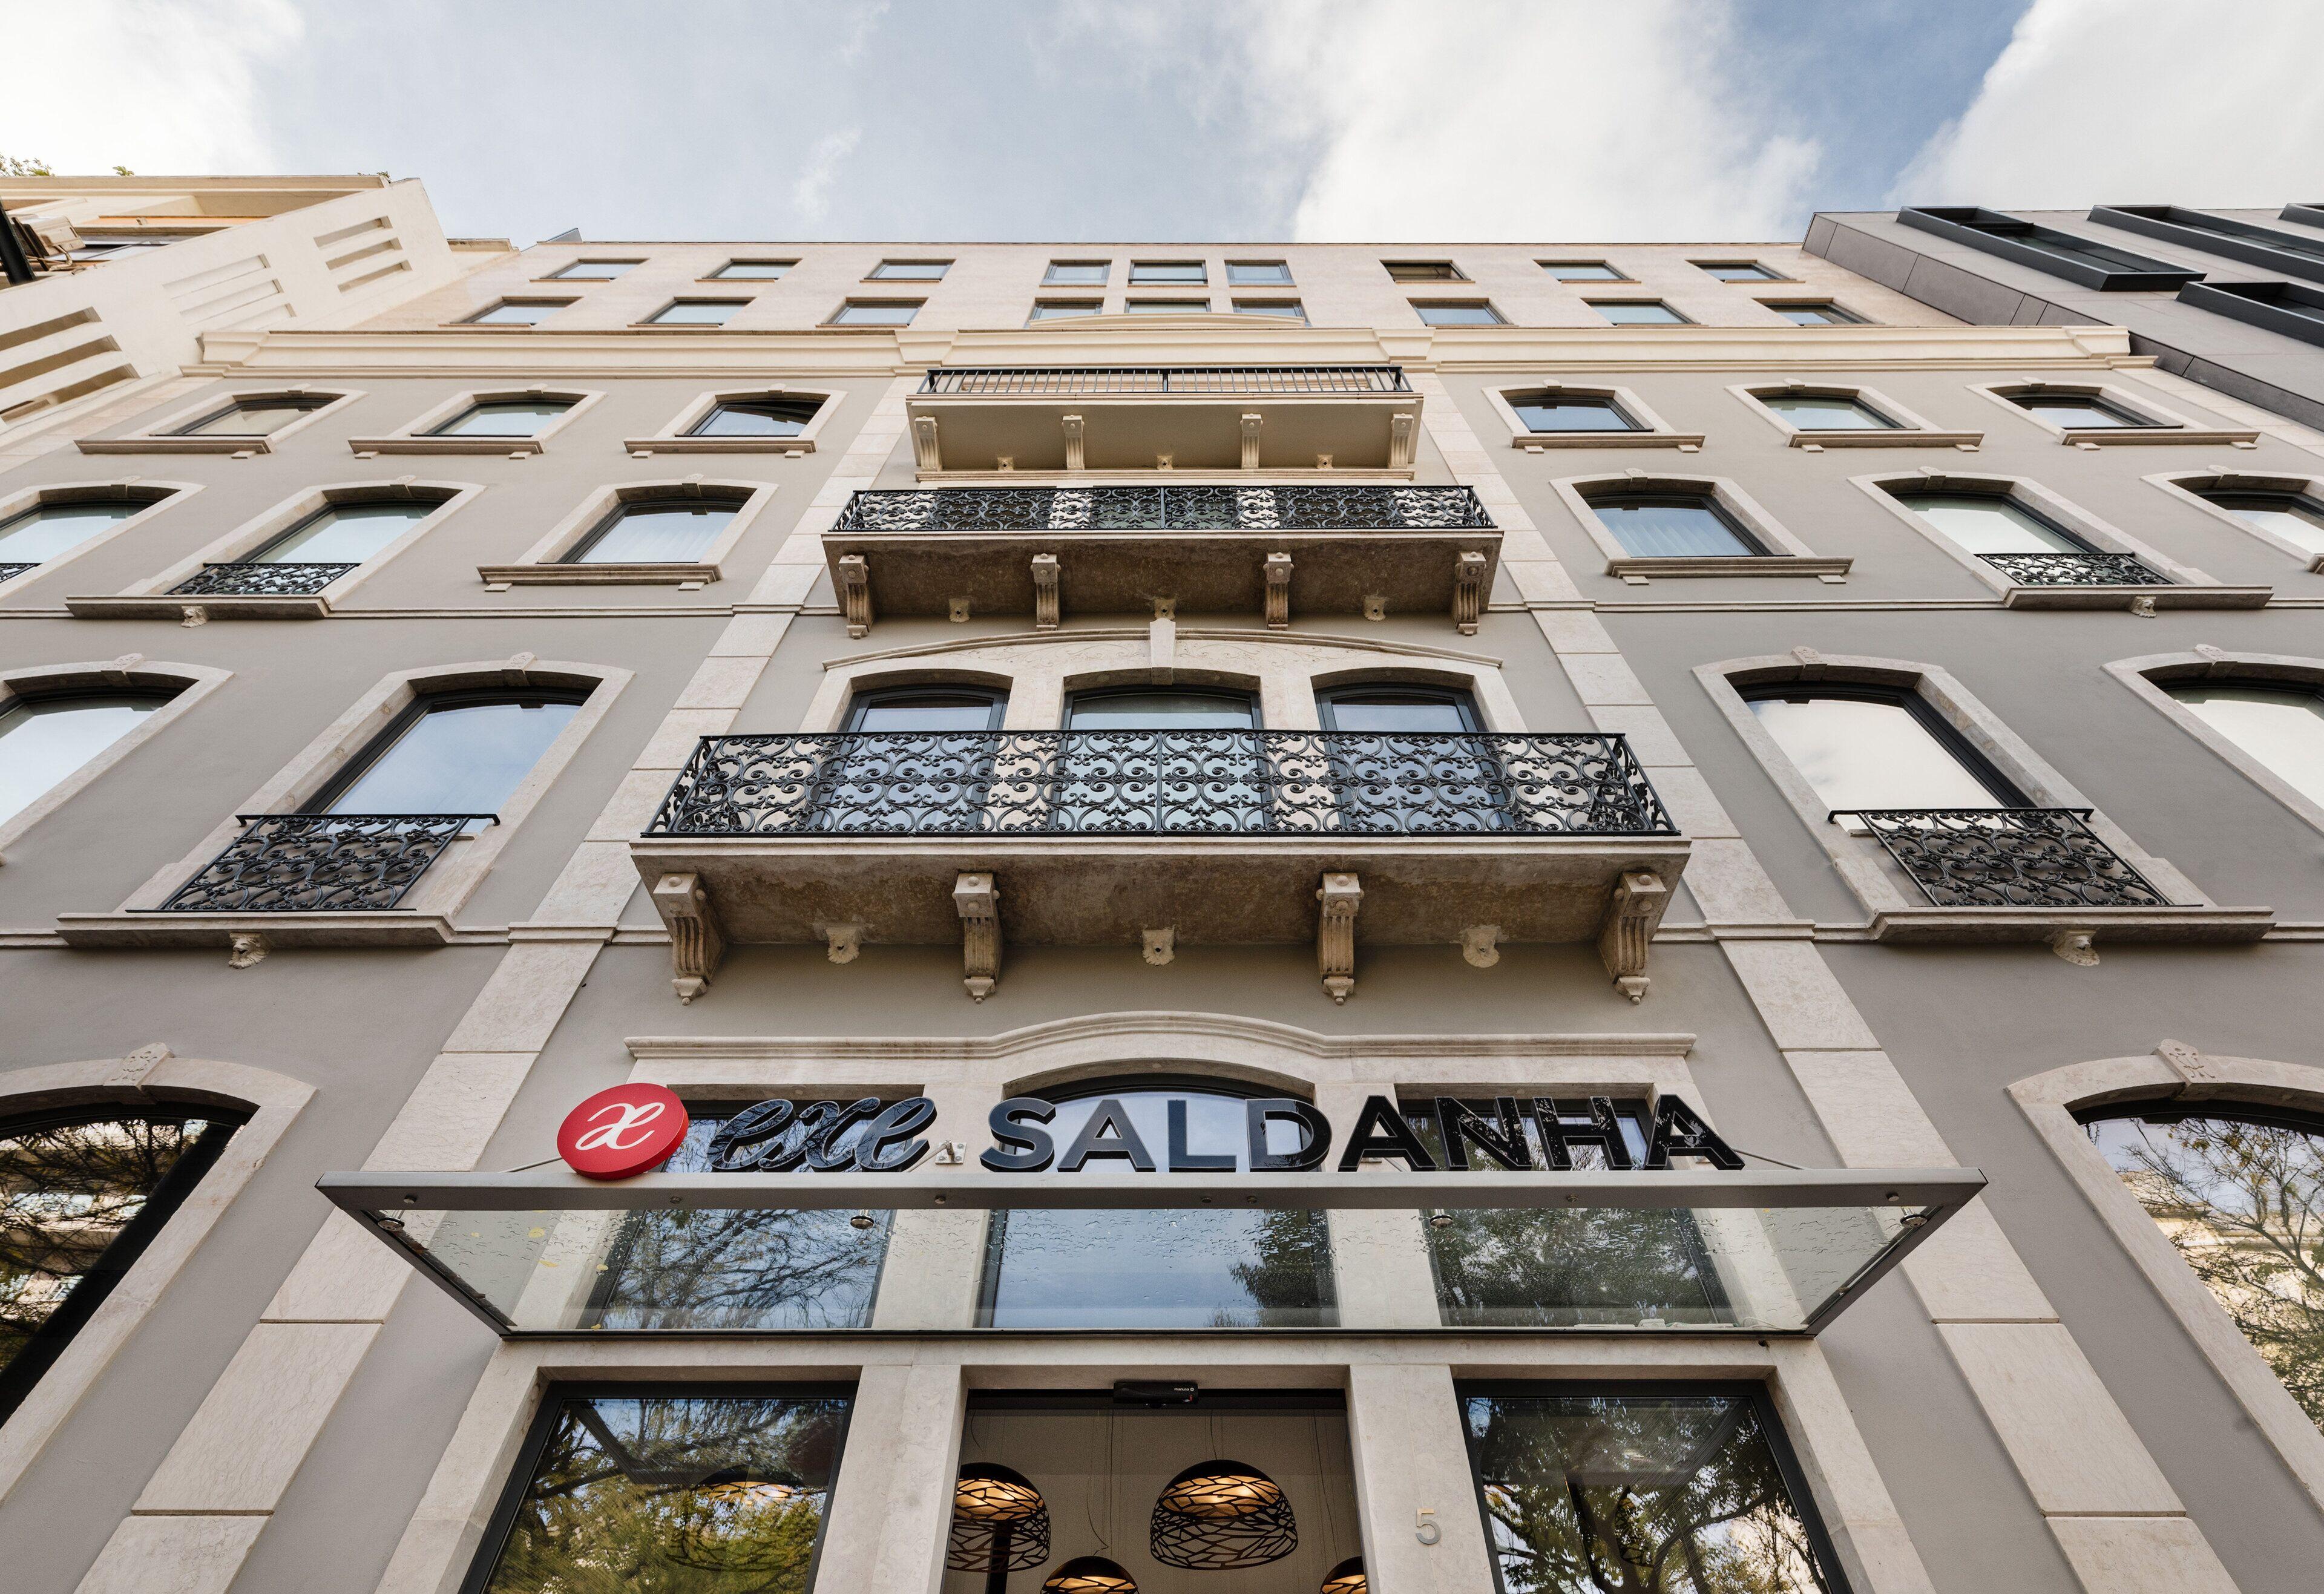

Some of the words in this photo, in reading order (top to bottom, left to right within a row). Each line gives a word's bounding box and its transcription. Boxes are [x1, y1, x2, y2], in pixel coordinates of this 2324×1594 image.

[707, 1097, 937, 1172] exe
[979, 1094, 1745, 1173] SALDANHA
[1416, 1508, 1441, 1545] 5
